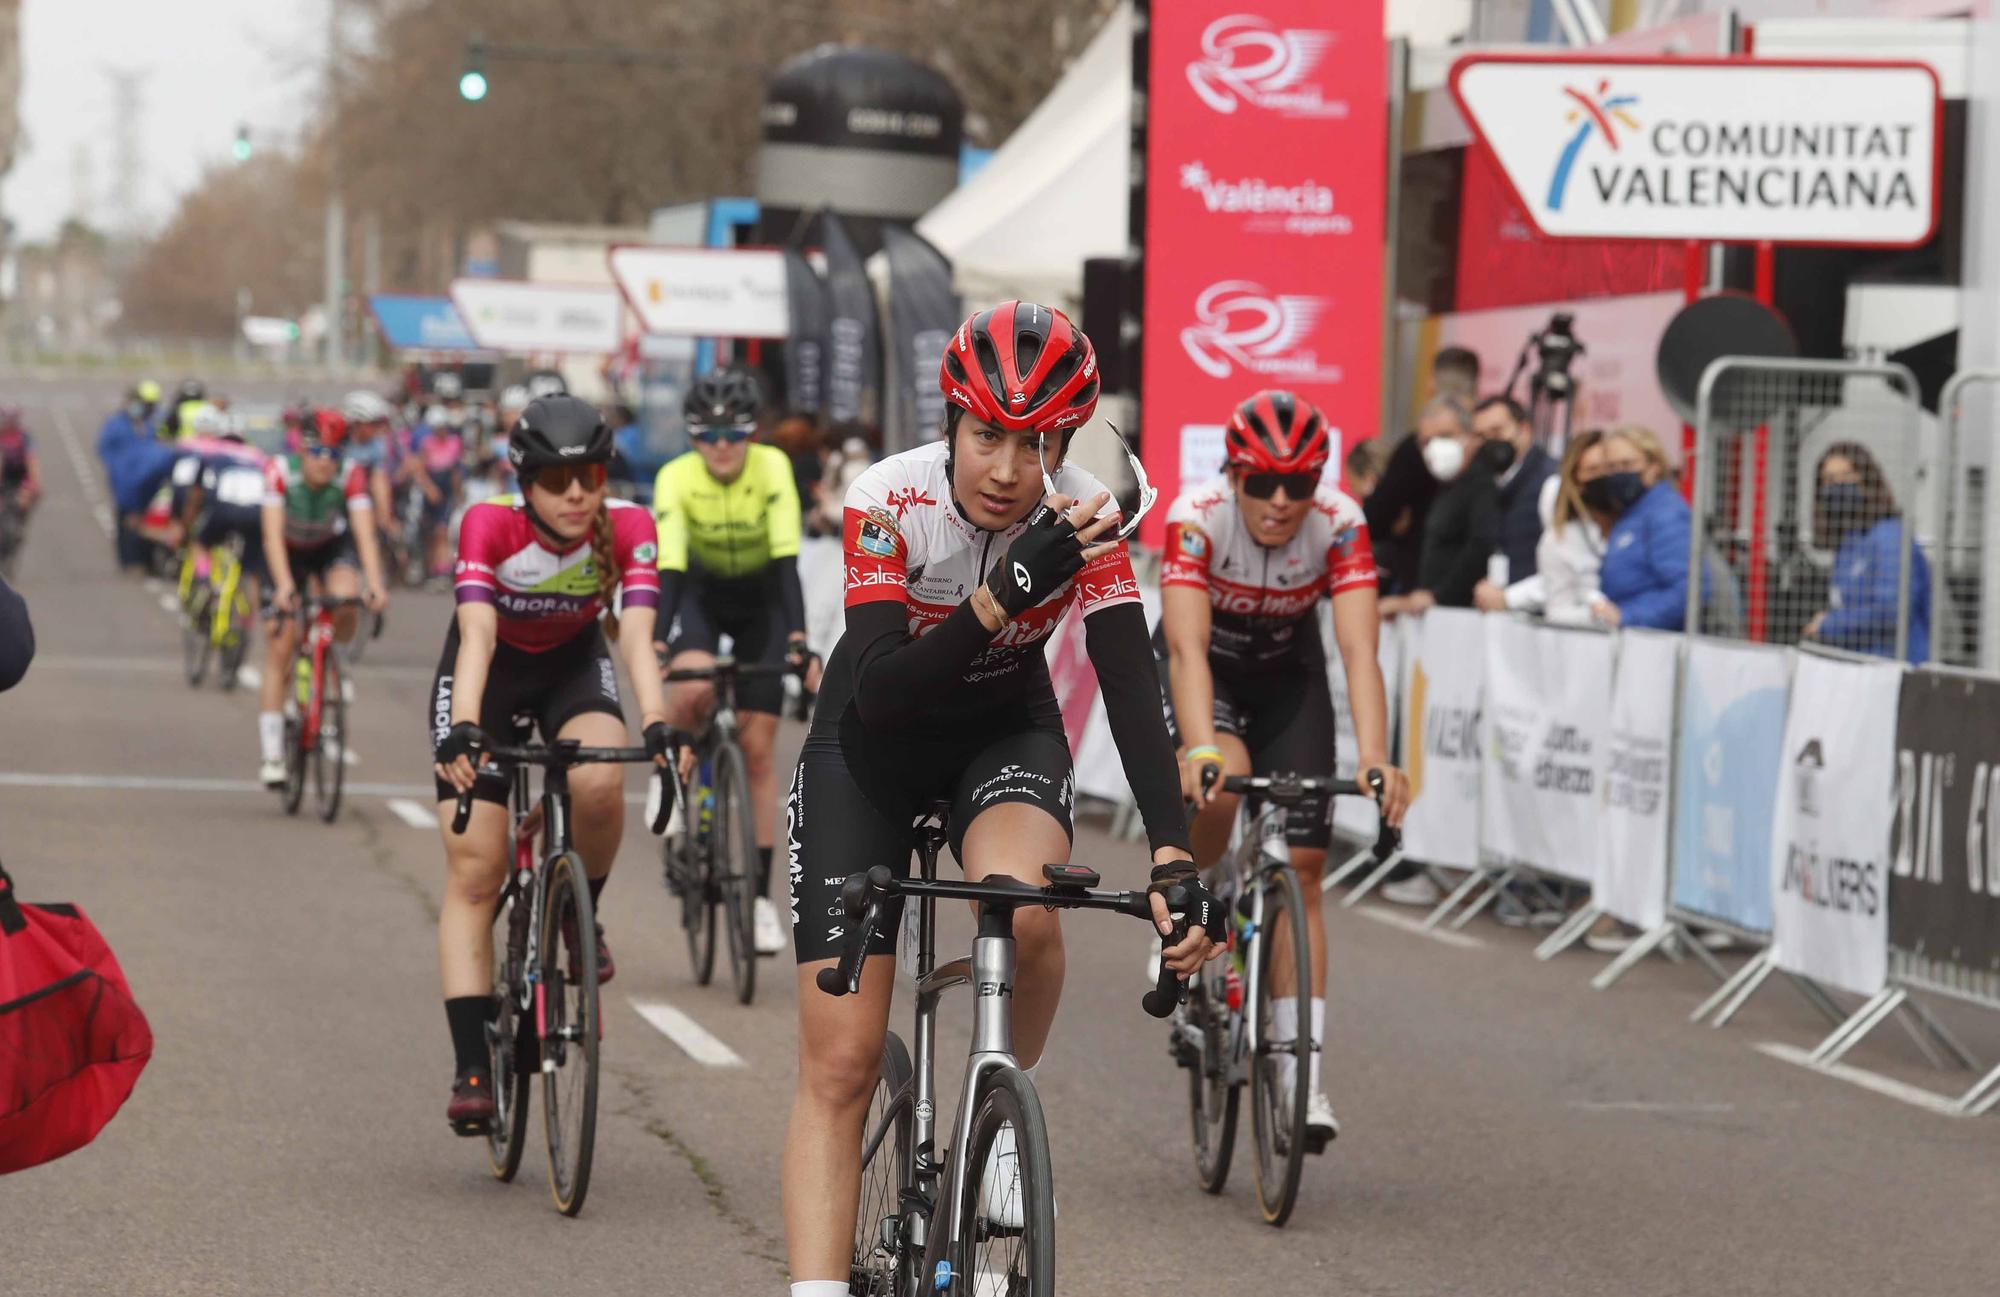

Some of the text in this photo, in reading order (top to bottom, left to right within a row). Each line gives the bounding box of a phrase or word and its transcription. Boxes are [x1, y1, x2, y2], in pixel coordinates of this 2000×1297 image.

[1652, 122, 1913, 157] COMUNITAT
[1202, 178, 1333, 214] València
[1592, 167, 1916, 208] VALENCIANA
[1031, 507, 1048, 526] GIRO
[972, 770, 1051, 801] Dromedario
[1201, 901, 1209, 925] GIRO
[978, 981, 1013, 998] BH
